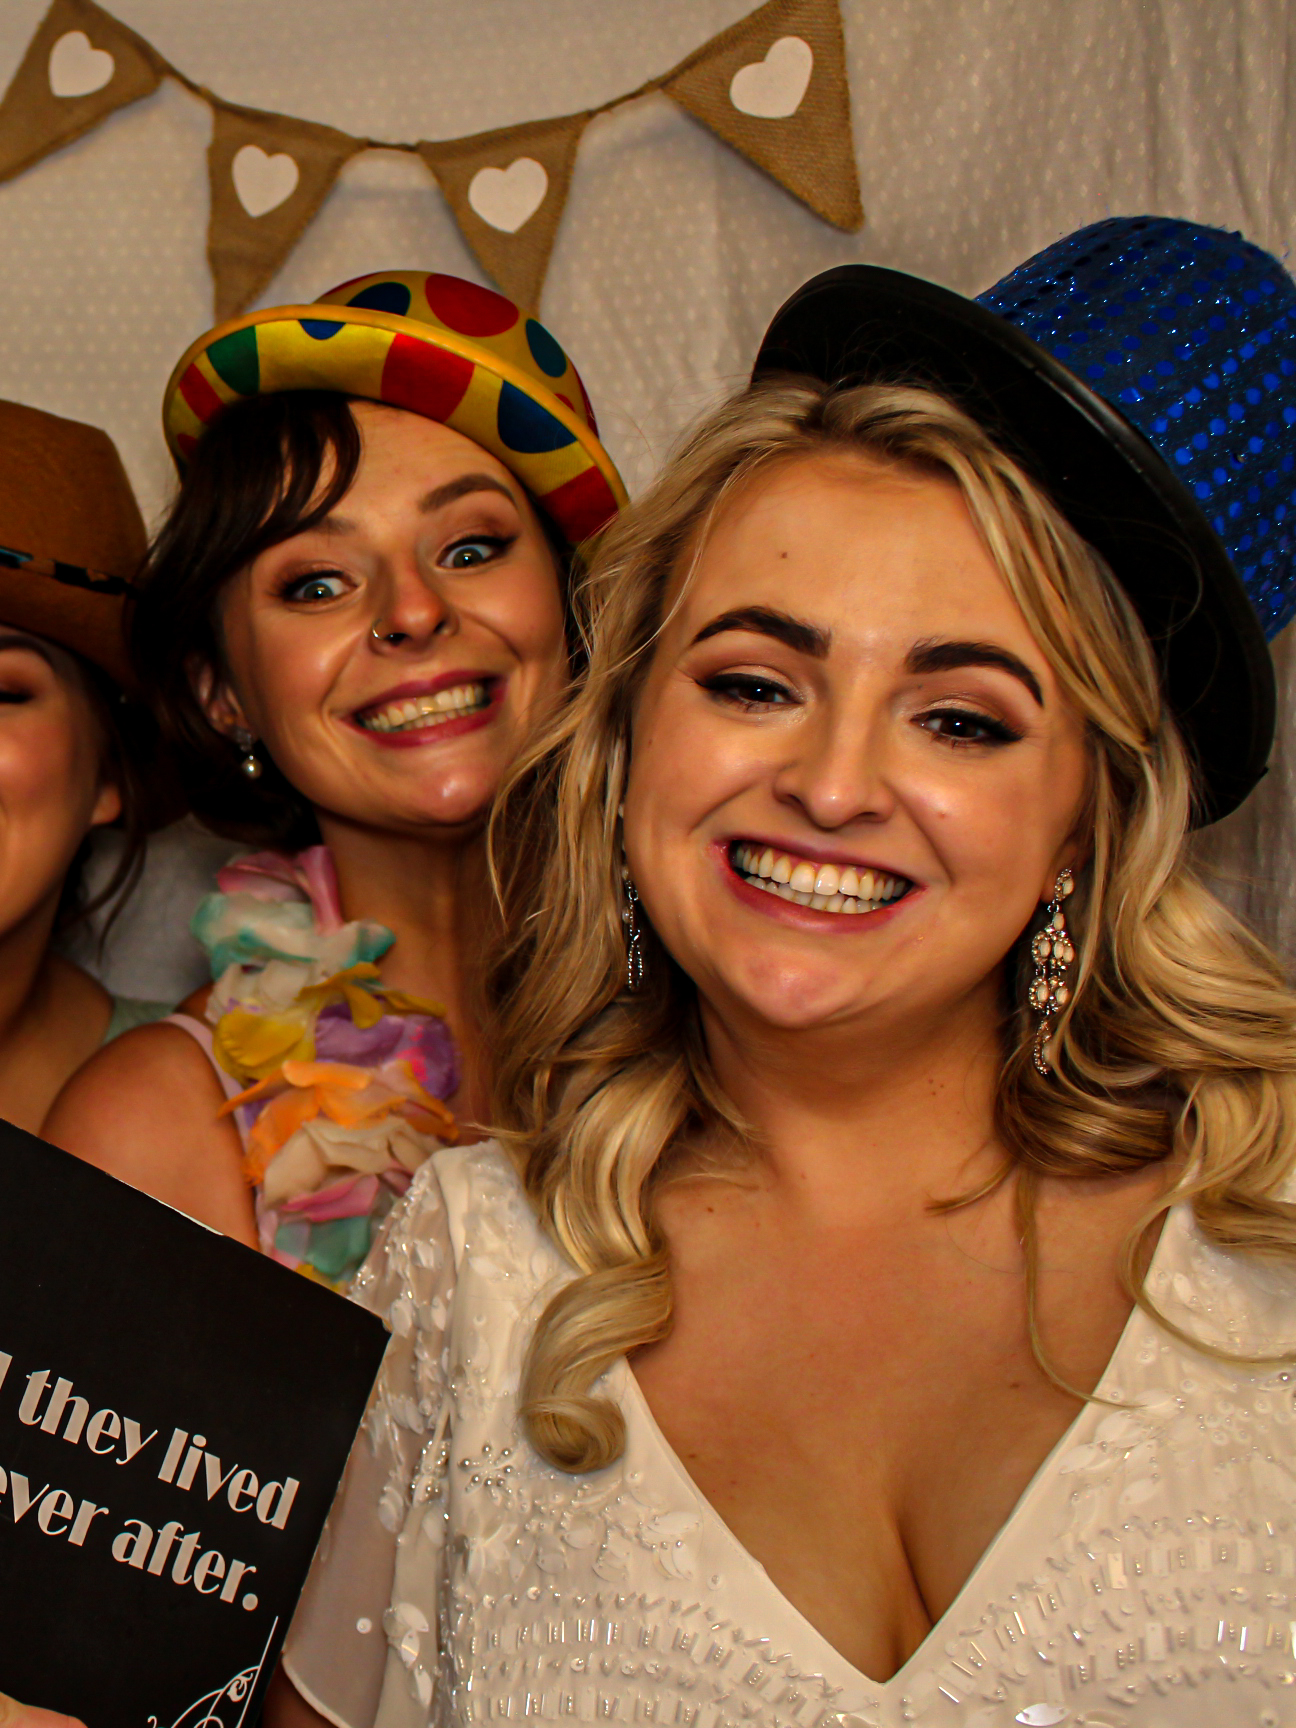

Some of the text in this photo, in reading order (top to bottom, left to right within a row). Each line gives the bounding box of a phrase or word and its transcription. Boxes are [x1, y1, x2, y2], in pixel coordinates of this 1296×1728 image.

[18, 1369, 158, 1465] they
[158, 1428, 300, 1530] lived
[111, 1519, 259, 1612] after.
